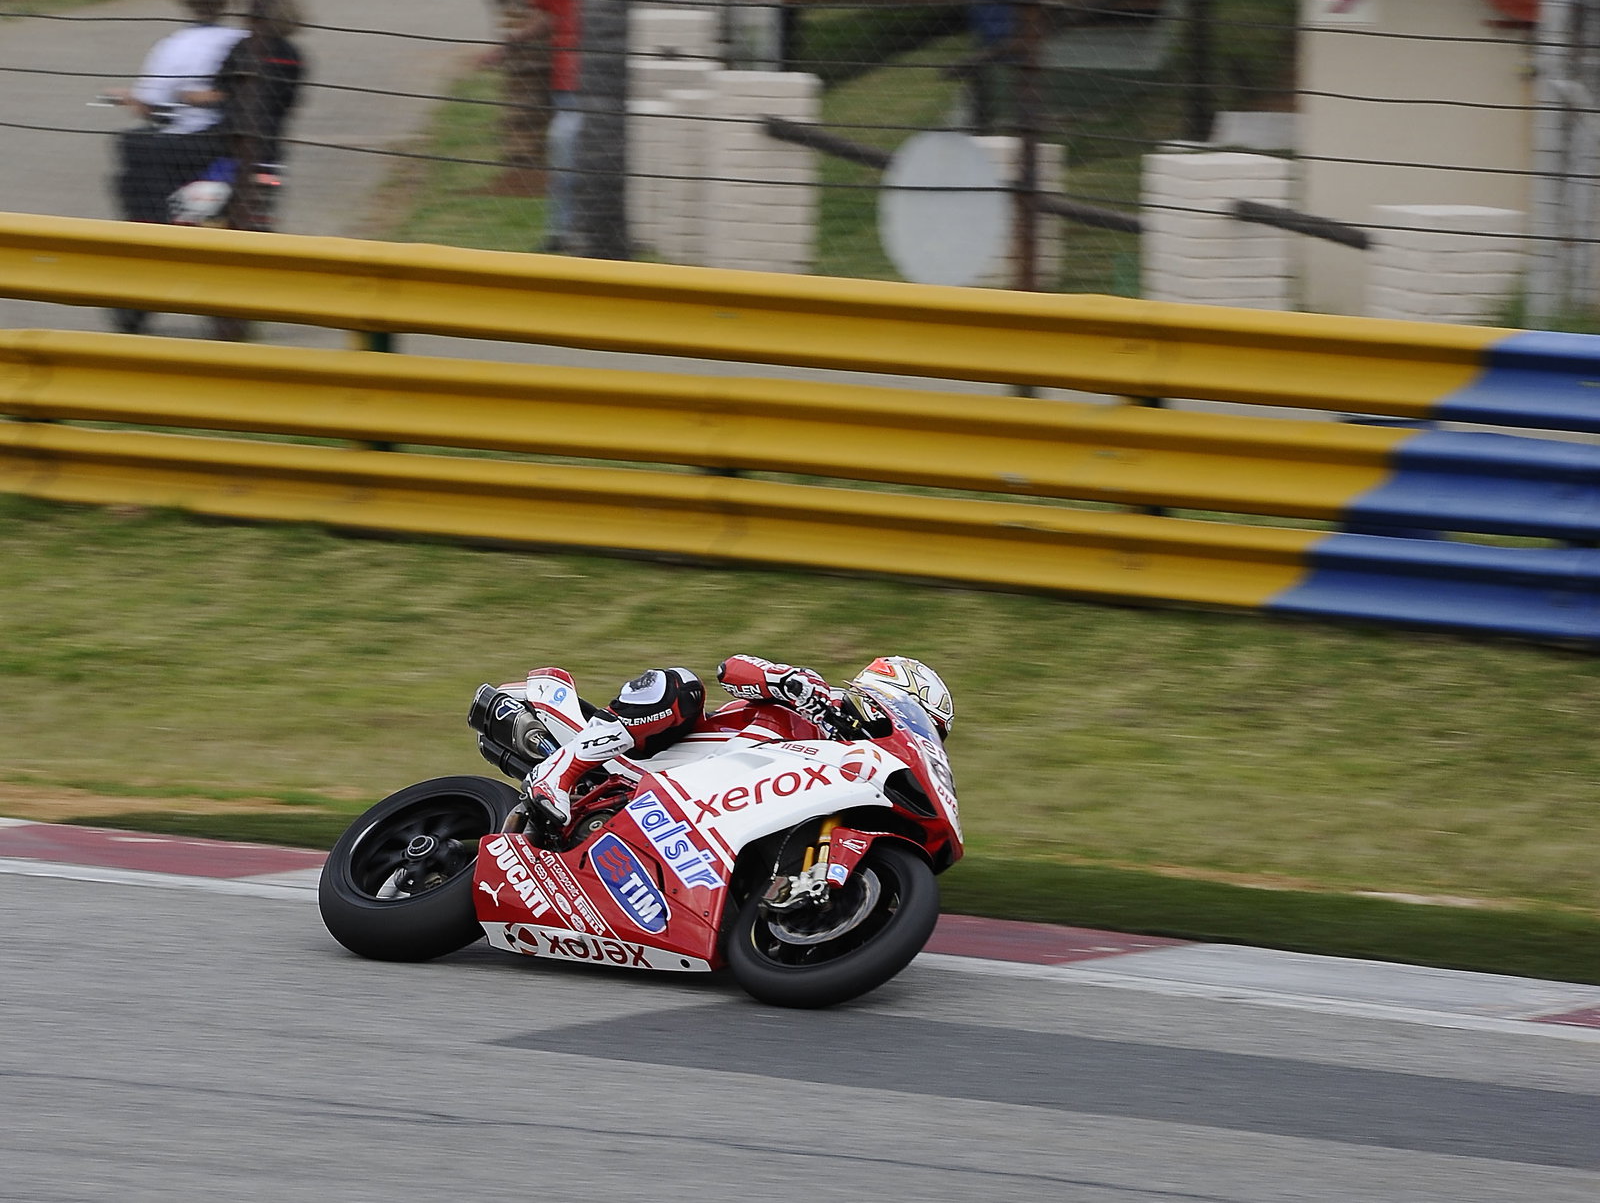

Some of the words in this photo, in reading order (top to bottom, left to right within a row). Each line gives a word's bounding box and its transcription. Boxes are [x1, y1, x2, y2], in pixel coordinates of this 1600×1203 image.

[581, 733, 622, 748] TCX
[780, 743, 820, 756] 1198
[694, 765, 832, 823] xerox
[630, 794, 720, 887] valsir
[486, 836, 550, 918] DUCATI
[619, 872, 663, 923] TIM
[540, 931, 653, 969] xerox
